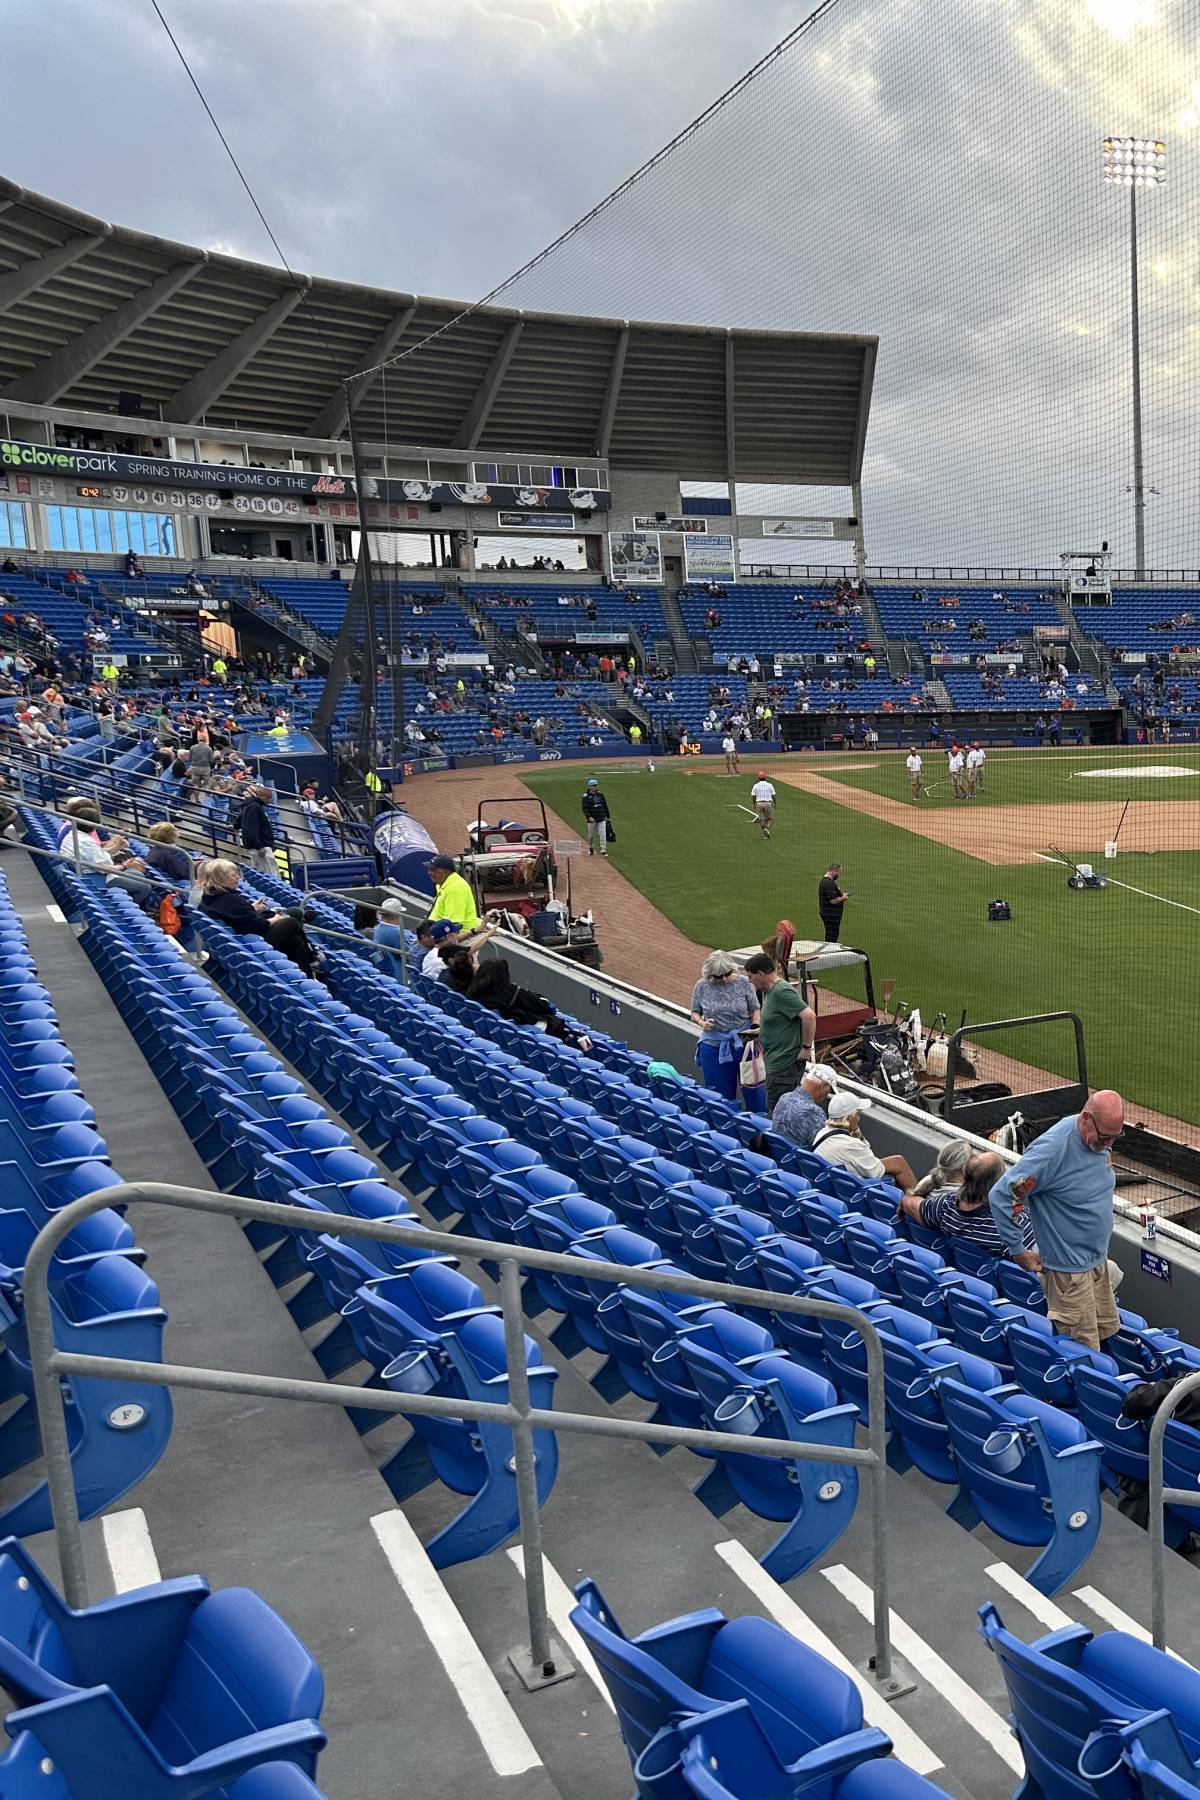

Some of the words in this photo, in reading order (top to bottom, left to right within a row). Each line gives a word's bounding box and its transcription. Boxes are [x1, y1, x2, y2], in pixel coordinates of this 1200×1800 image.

[21, 447, 118, 473] cloverpark
[128, 463, 170, 478] SPRING
[172, 467, 226, 483] TRAINING
[228, 473, 265, 486] HOME
[266, 475, 283, 487] OF
[286, 478, 308, 489] THE
[312, 476, 346, 494] Mets
[114, 488, 127, 499] 37
[135, 491, 145, 502] 14
[154, 492, 165, 502] 41
[173, 494, 184, 505] 31
[189, 494, 202, 505] 36
[207, 495, 219, 507] 17
[236, 496, 248, 508] 24
[253, 498, 264, 509] 16
[270, 499, 281, 510] 18
[285, 502, 298, 513] 42
[539, 752, 559, 761] SNY
[122, 1410, 132, 1420] F
[826, 1486, 834, 1495] D
